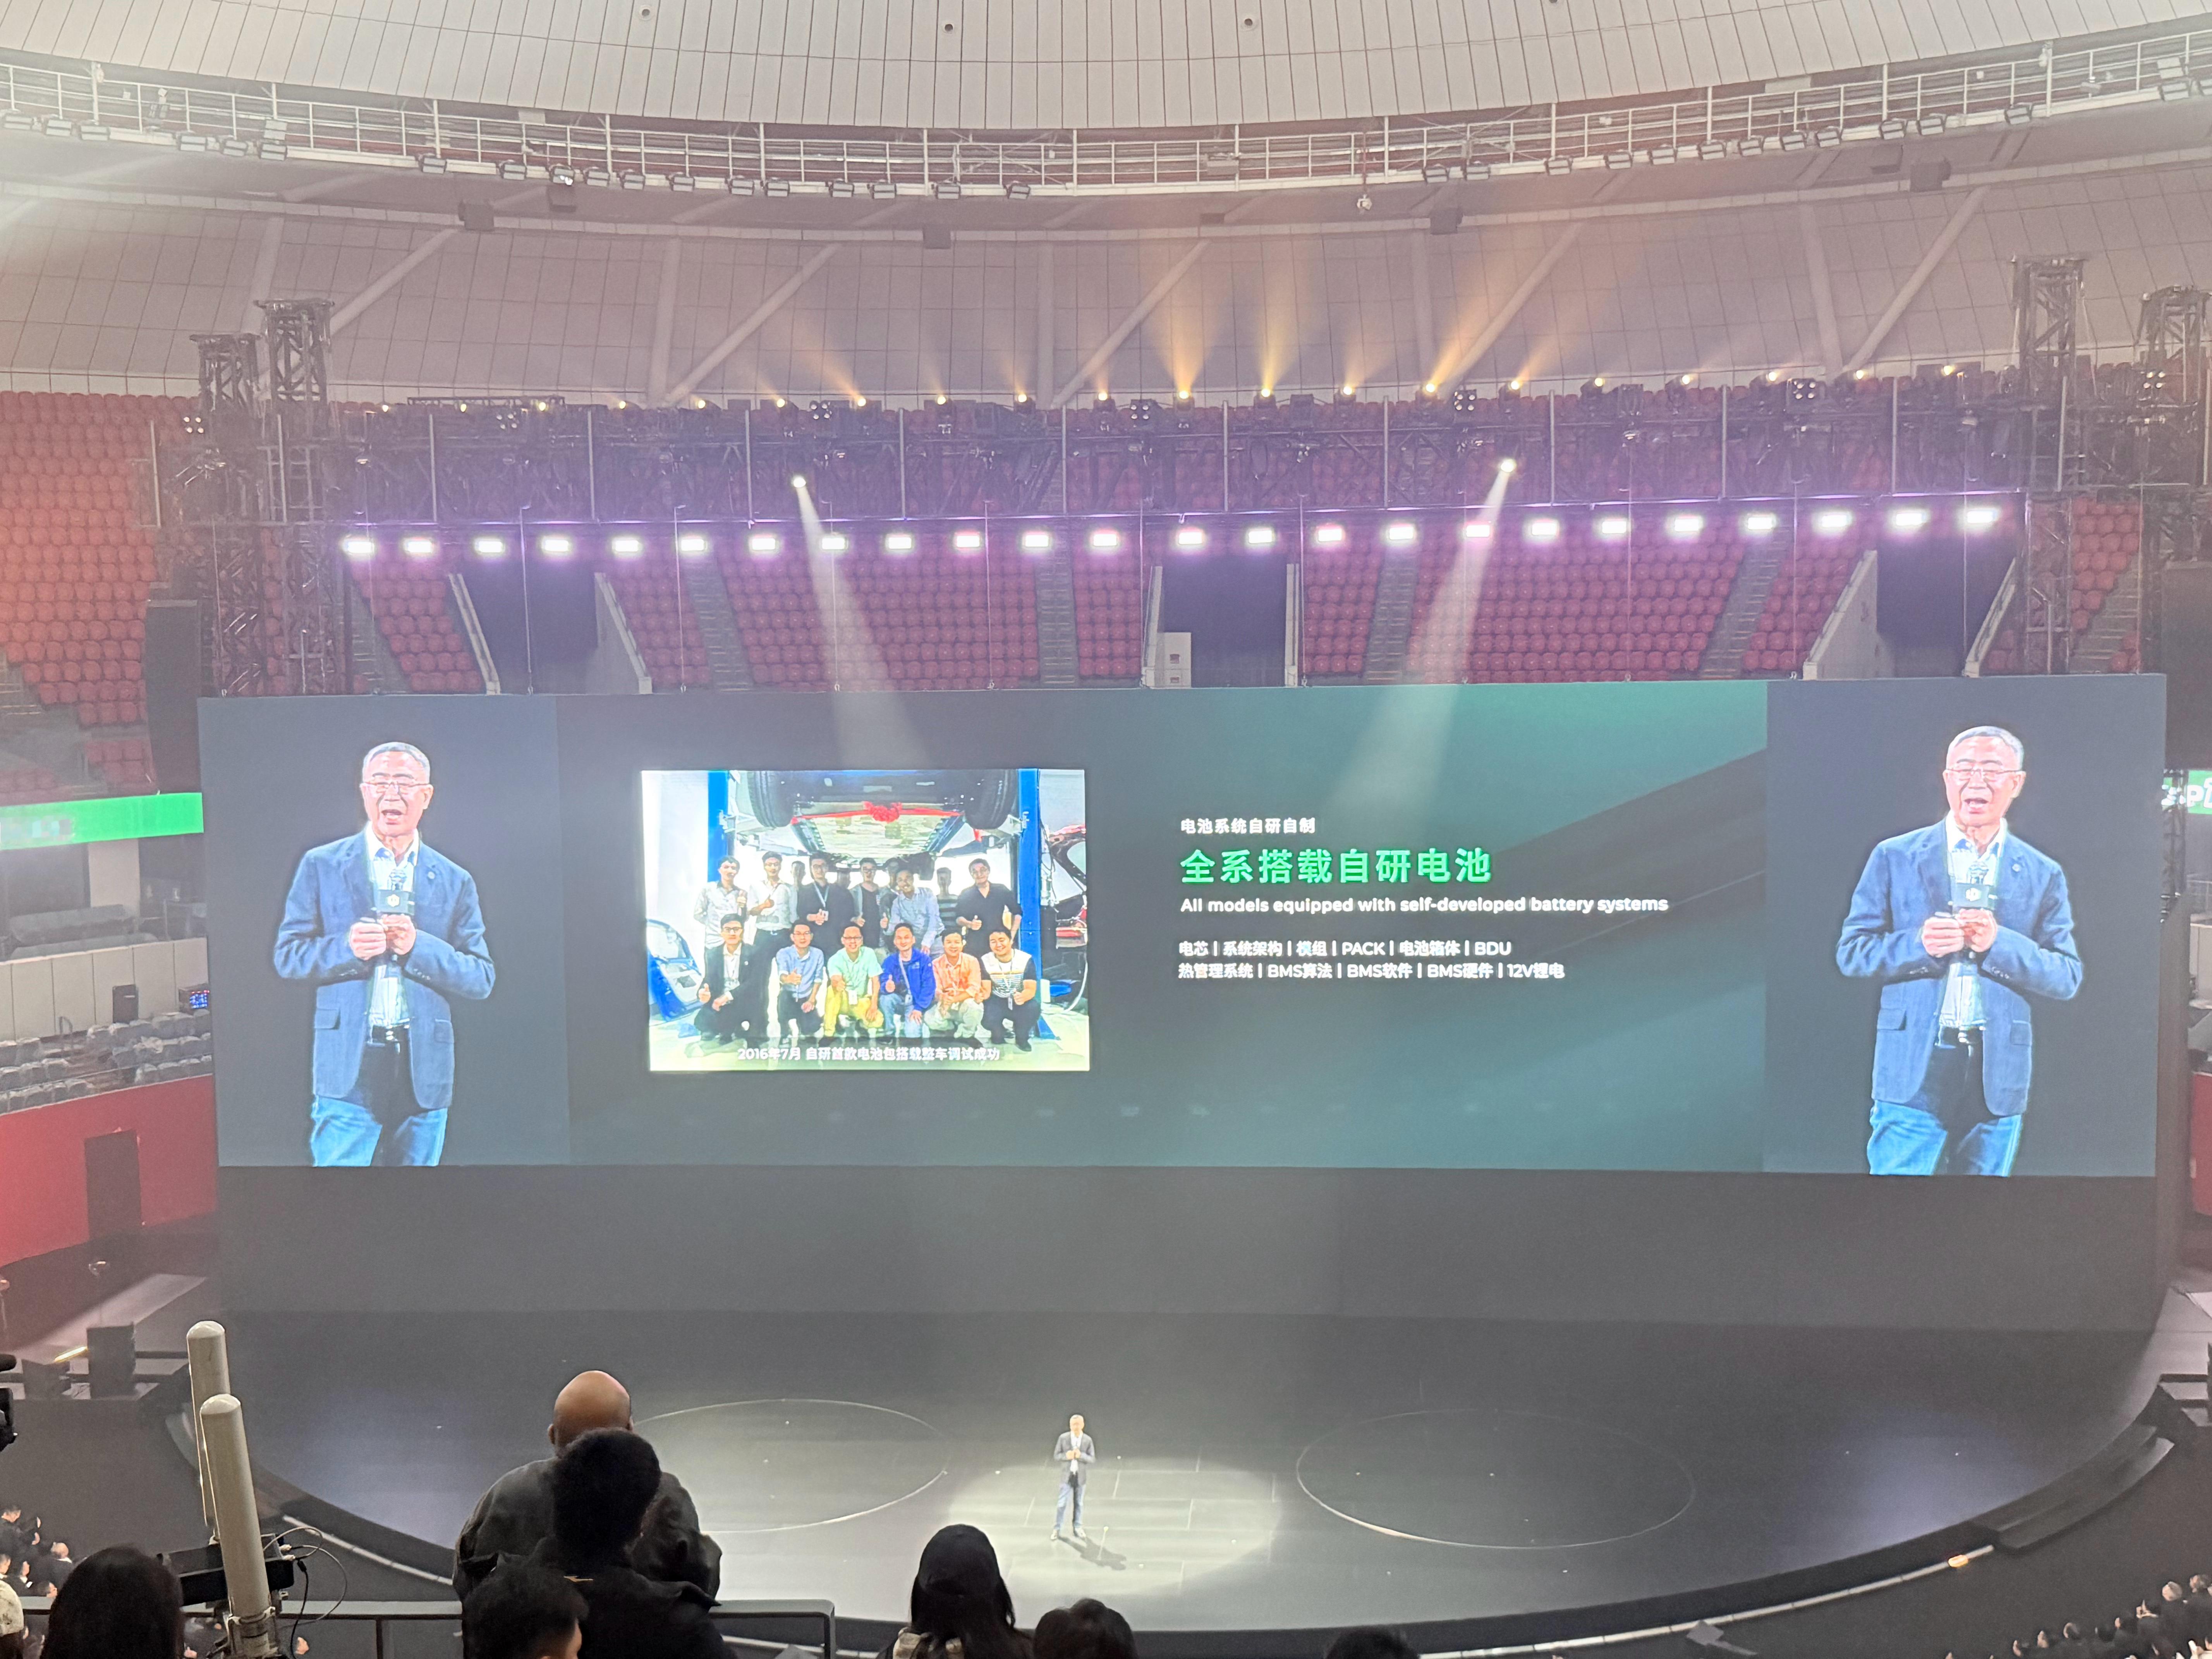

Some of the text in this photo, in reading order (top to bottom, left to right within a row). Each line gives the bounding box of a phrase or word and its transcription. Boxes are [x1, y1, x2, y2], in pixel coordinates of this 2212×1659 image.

[1181, 817, 1316, 834] 电池系统自研自制
[1180, 848, 1492, 883] 全系搭载自研电池
[1180, 896, 1669, 914] All models equipped with self-developed battery systems
[1179, 940, 1511, 957] 电芯 系统架构 模组 PACK 电池箱体 BDU
[1178, 963, 1254, 979] 热管理系统
[1267, 963, 1333, 979] BMS算法
[1347, 962, 1413, 979] BMS软件
[1427, 962, 1494, 979] BMS硬件
[738, 1048, 800, 1060] 2016年7月
